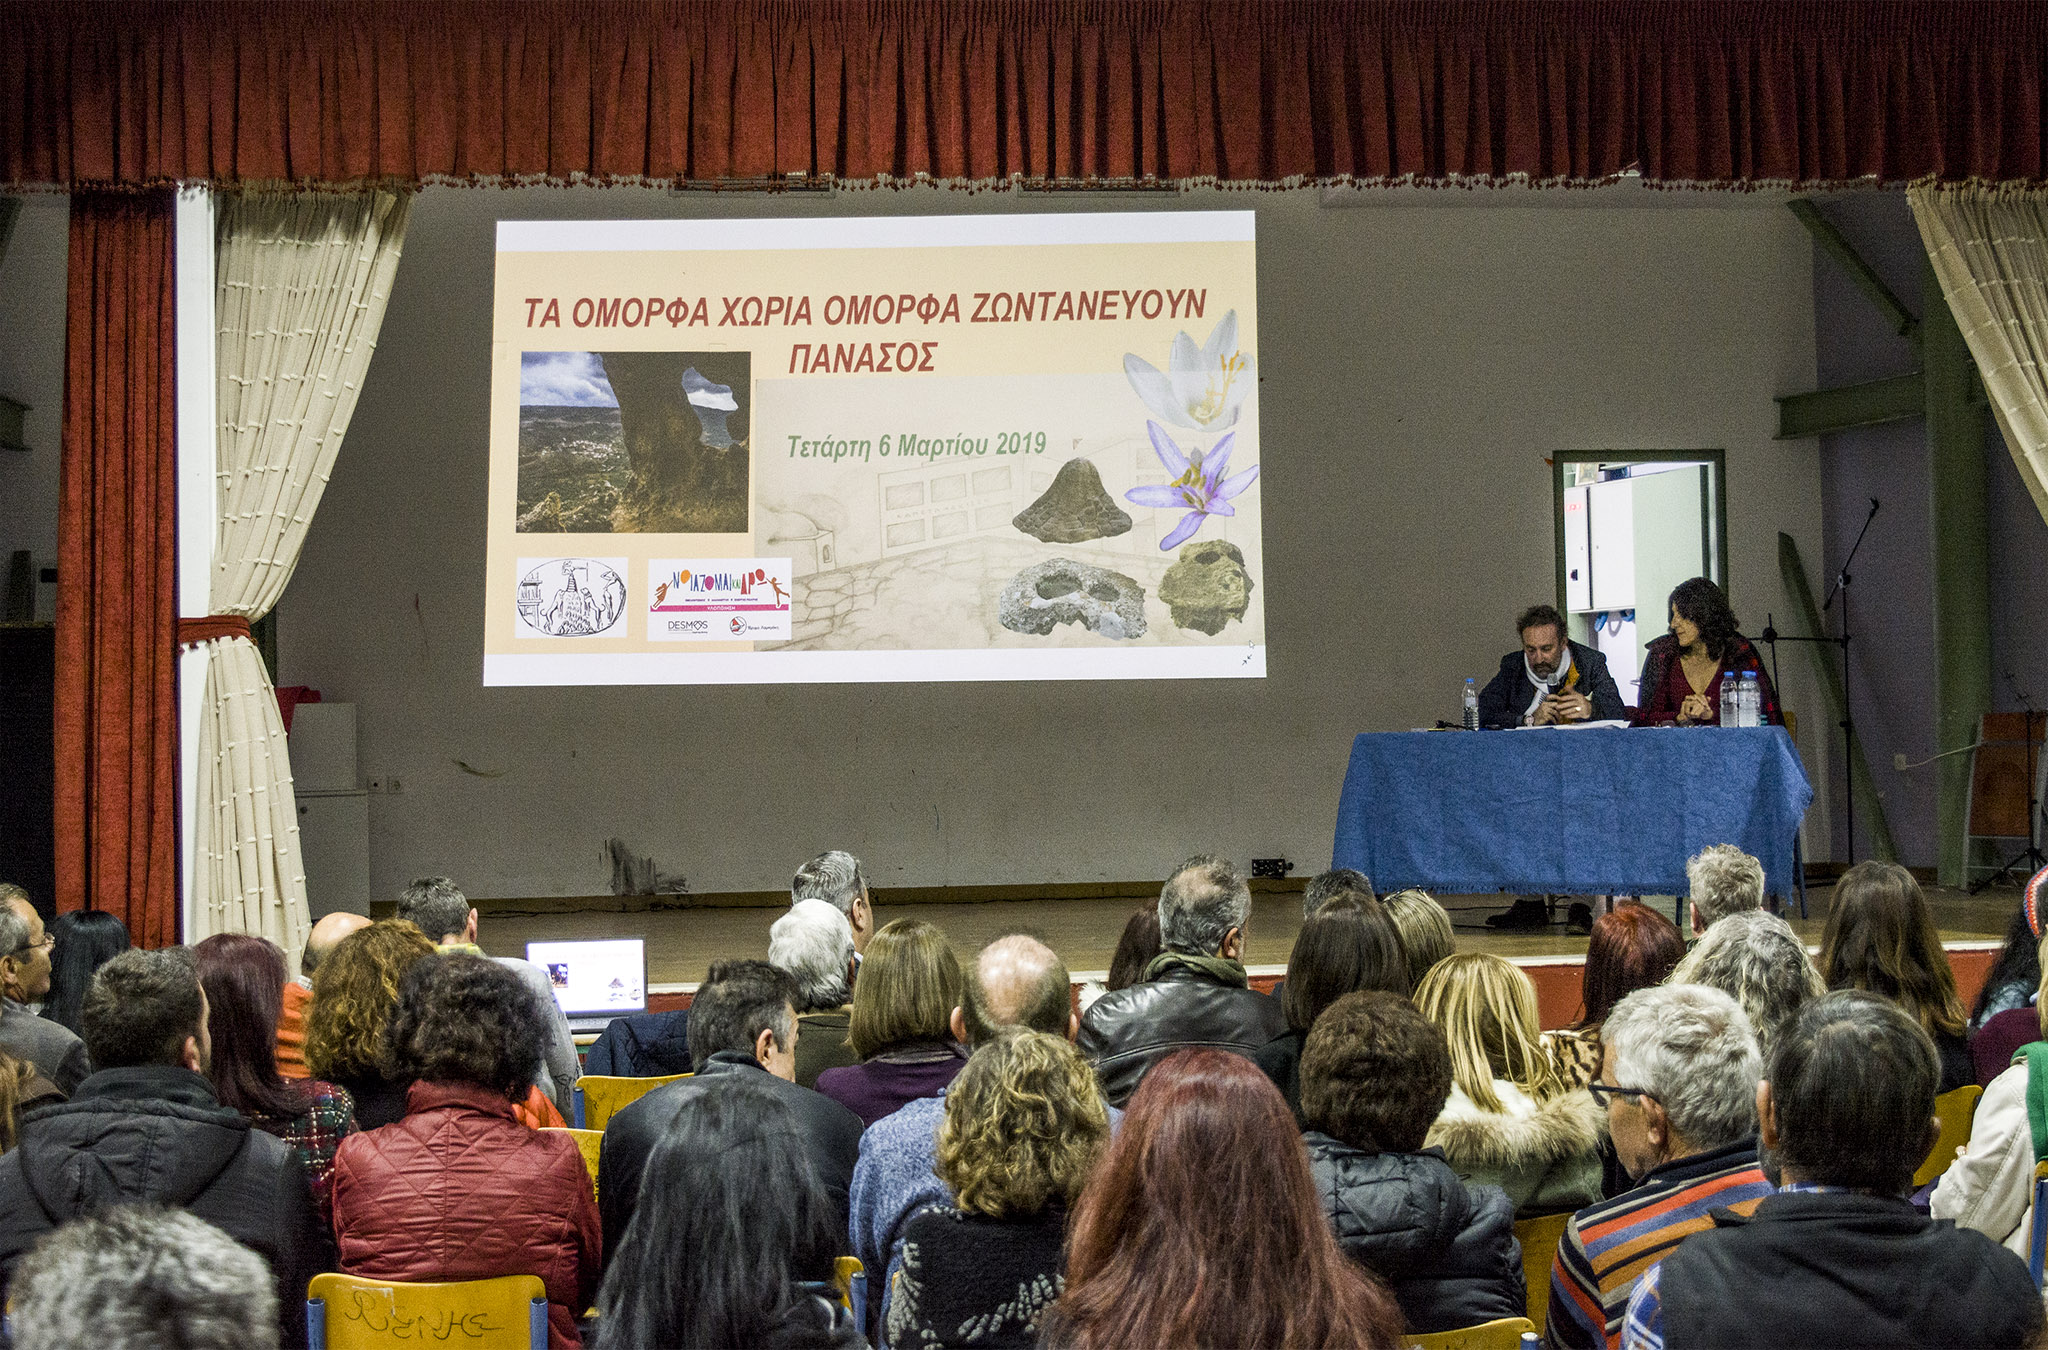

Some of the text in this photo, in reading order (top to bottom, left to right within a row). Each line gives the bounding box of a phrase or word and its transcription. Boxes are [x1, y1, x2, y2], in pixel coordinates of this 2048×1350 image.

[525, 289, 1207, 328] ΤΑ ΟΜΟΡΦΑ ΧΩΡΙΑ ΟΜΟΡΦΑ ΖΩΝΤΑΝΕΥΟΥΝ
[789, 341, 938, 374] ΠΑΝΑΣΟΣ
[788, 431, 1047, 463] Τετάρτη 6 Μαρτίου 2019
